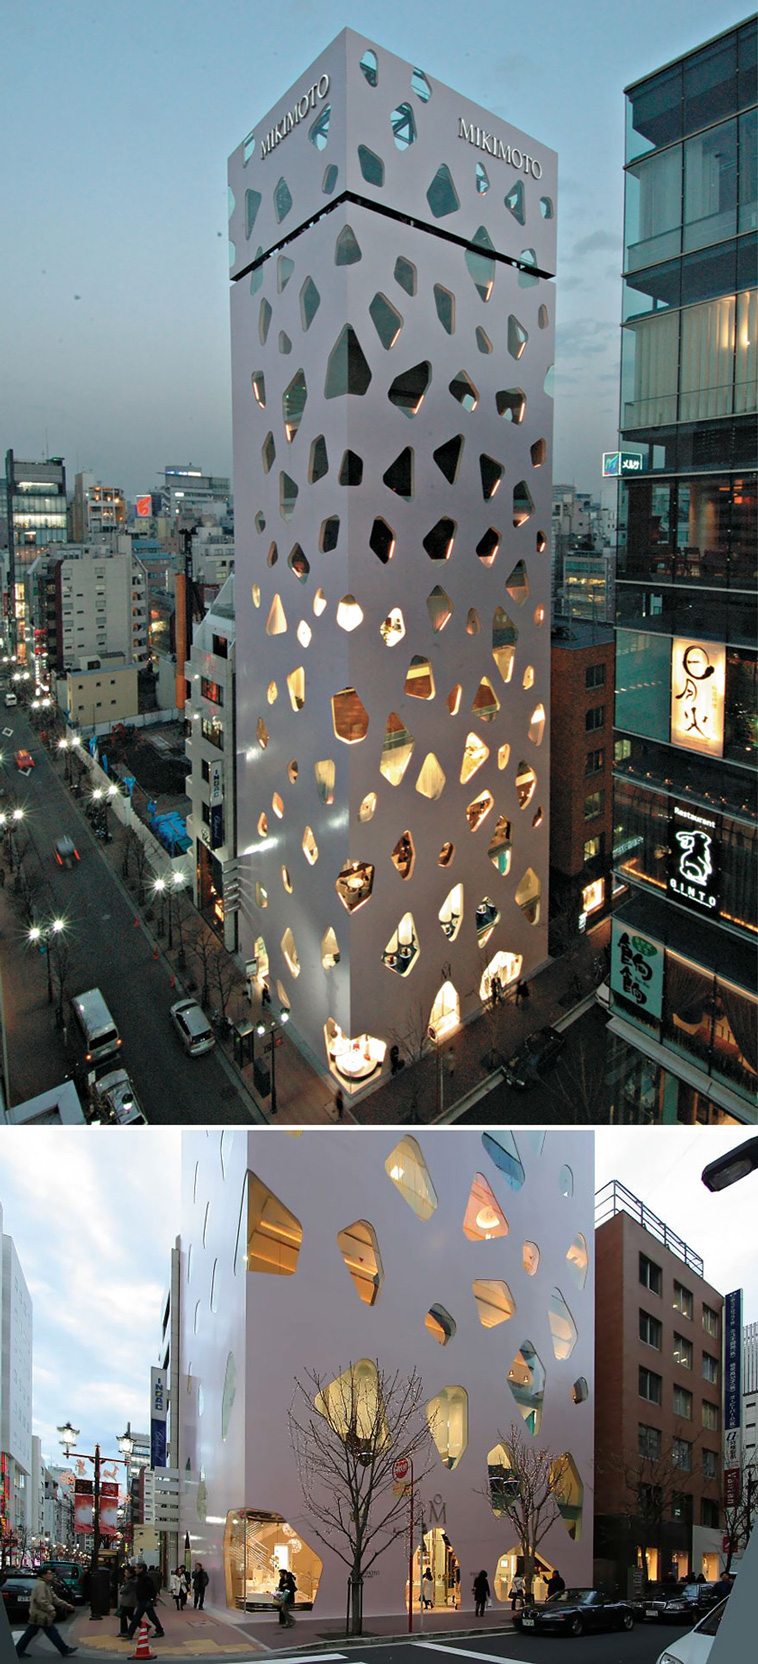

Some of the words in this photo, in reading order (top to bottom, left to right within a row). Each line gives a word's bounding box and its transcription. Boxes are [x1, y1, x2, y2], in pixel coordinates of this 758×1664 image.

[260, 74, 330, 160] MIKIMOTO
[458, 117, 543, 180] MIKIMOTO
[622, 459, 640, 470] メルサ
[674, 806, 716, 829] Restaurant
[670, 878, 716, 907] GINTO
